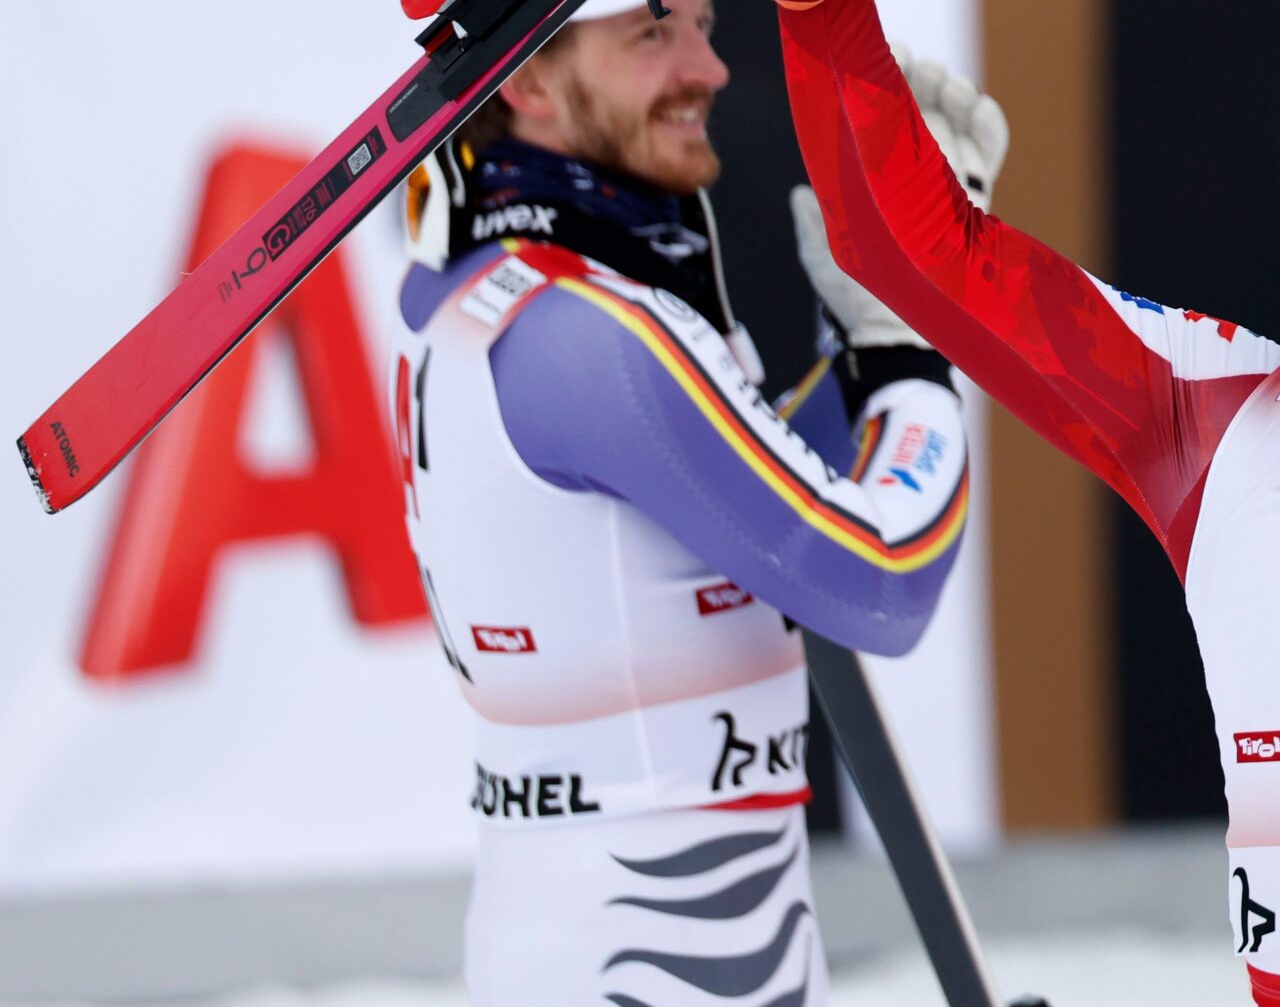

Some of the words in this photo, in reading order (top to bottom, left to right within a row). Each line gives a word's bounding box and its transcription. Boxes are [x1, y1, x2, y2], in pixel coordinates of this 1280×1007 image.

[301, 195, 317, 222] 176
[472, 204, 558, 240] uvex
[50, 421, 80, 478] ATOMIC
